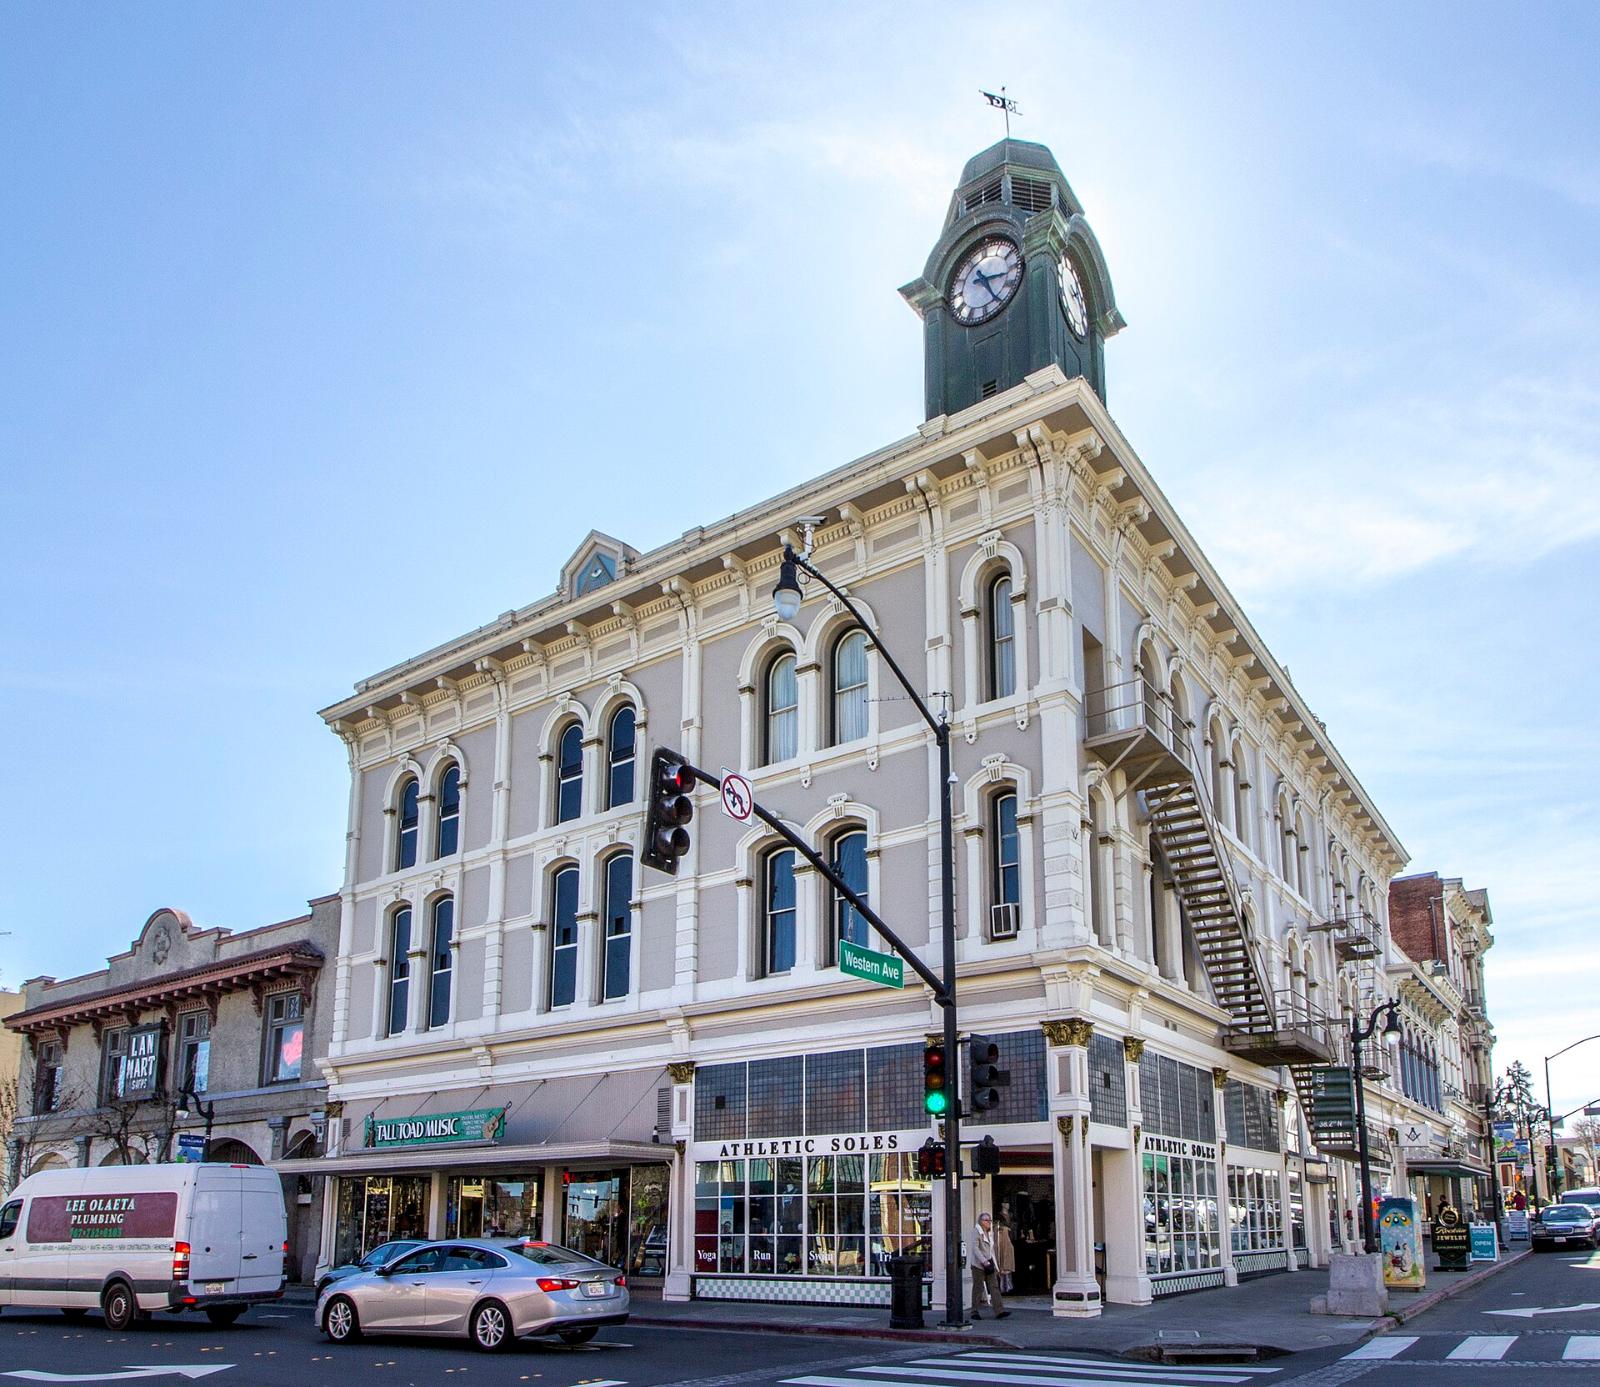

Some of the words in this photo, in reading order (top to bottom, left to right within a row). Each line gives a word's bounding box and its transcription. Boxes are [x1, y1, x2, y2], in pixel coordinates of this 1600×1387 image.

[844, 949, 880, 975] Western
[882, 962, 899, 980] Ave
[131, 1033, 155, 1057] LAN
[126, 1055, 156, 1079] MART
[377, 1124, 397, 1141] TALL
[398, 1121, 424, 1139] TOAD
[425, 1118, 459, 1137] MUSIC
[720, 1139, 816, 1157] ATHLETIC
[831, 1135, 898, 1152] SOLES
[1144, 1136, 1187, 1155] ATHLETIC
[1191, 1144, 1216, 1160] SOLES
[65, 1199, 87, 1212] LEE
[89, 1198, 136, 1212] OLAETA
[71, 1214, 125, 1224] PLUMBING
[697, 1249, 717, 1262] Yoga
[753, 1249, 771, 1260] Run
[808, 1250, 833, 1261] Swim
[878, 1251, 892, 1262] Tri
